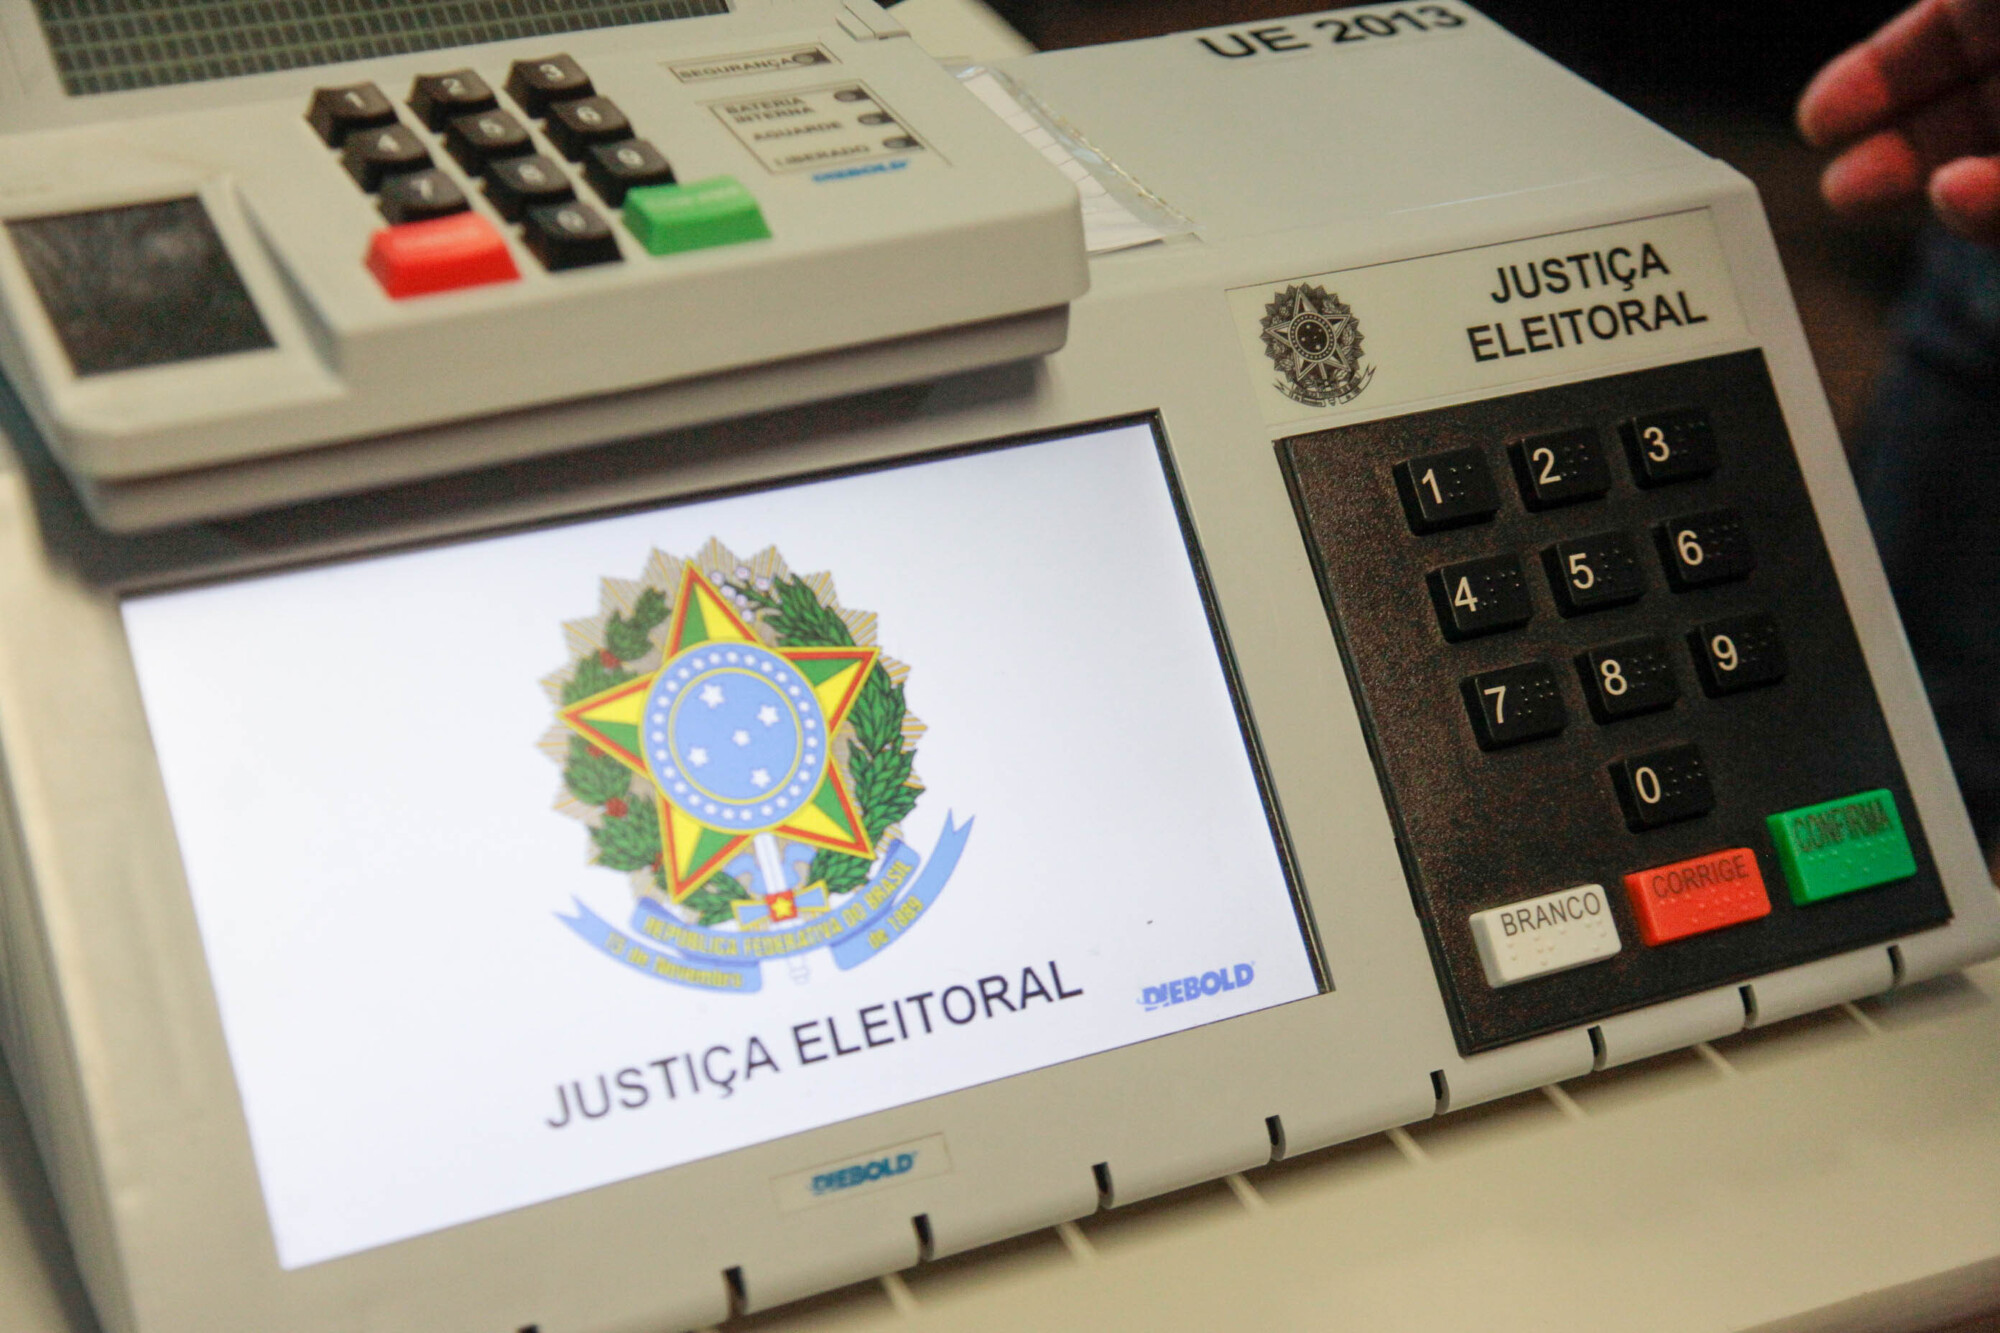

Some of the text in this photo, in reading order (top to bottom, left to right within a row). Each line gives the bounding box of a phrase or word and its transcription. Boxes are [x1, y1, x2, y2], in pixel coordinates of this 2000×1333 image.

[1197, 2, 1468, 60] UE 2013
[442, 77, 466, 95] 2
[539, 63, 564, 80] 3
[679, 57, 795, 79] SEGURANÇA
[345, 92, 364, 108] 1
[576, 106, 602, 123] 6
[724, 97, 804, 115] BATERIA
[378, 134, 401, 151] 4
[774, 144, 871, 166] LIBERADO
[1490, 243, 1670, 304] JUSTIÇA
[1467, 291, 1708, 363] ELEITORAL
[1643, 427, 1670, 462] 3
[1532, 448, 1561, 485] 2
[1421, 469, 1443, 504] 1
[1677, 530, 1703, 566] 6
[1568, 553, 1595, 590] 5
[1453, 577, 1478, 613] 4
[1712, 635, 1738, 672] 9
[1600, 659, 1628, 696] 8
[1484, 686, 1507, 724] 7
[1635, 767, 1661, 804] 0
[1651, 855, 1750, 899] CORRIGE
[1501, 891, 1602, 938] BRANCO
[1138, 961, 1256, 1011] DIEBOLD
[544, 959, 1083, 1129] JUSTIÇA ELEITORAL
[807, 1150, 918, 1196] DIEBOLD
